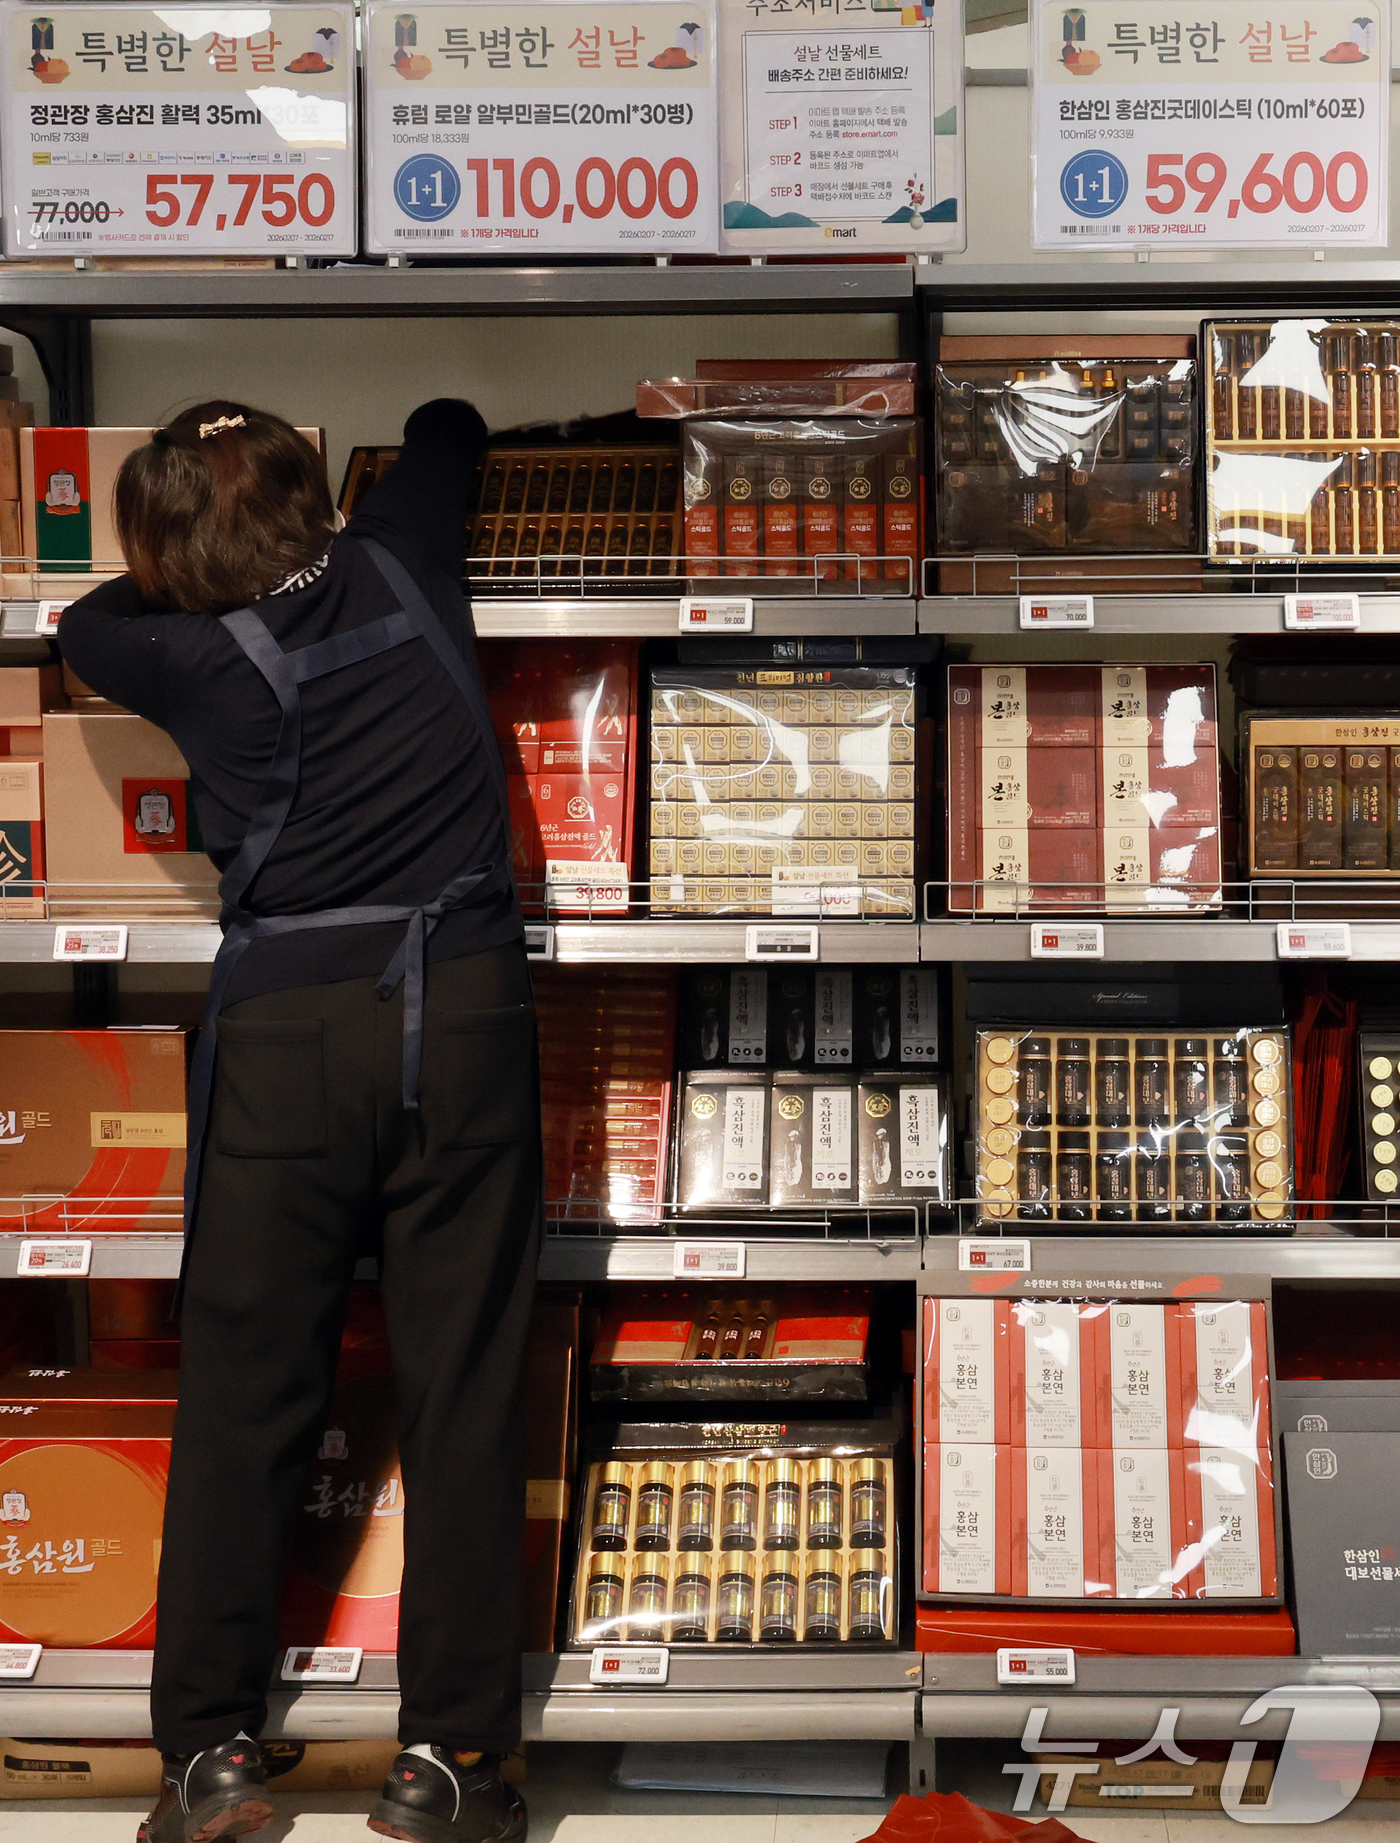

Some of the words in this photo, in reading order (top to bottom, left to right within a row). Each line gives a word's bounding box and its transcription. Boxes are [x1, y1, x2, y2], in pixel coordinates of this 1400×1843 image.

[438, 25, 555, 70] 특별한
[567, 25, 646, 69] 설날
[1107, 20, 1226, 65] 특별한
[1238, 20, 1318, 64] 설날
[75, 31, 192, 73] 특별한
[204, 31, 282, 73] 설날
[793, 45, 822, 63] 설날
[825, 44, 883, 61] 선물세트
[768, 69, 815, 83] 배송주소
[817, 68, 842, 82] 간편
[845, 66, 909, 81] 준비하세요!
[30, 104, 89, 126] 정관장
[95, 104, 154, 126] 홍삼진
[161, 104, 200, 126] 활력
[392, 104, 428, 126] 휴럼
[434, 104, 471, 126] 로얄
[808, 107, 831, 117] 이마트
[832, 107, 840, 116] 앱
[841, 107, 857, 116] 택배
[857, 107, 872, 116] 발송
[875, 106, 889, 115] 주소
[891, 106, 906, 115] 등록
[1059, 100, 1110, 121] 한삼인
[1116, 99, 1252, 121] 홍삼진굿데이스틱
[769, 119, 791, 130] STEP
[793, 116, 798, 130] 1
[808, 119, 831, 128] 이마트
[832, 118, 875, 128] 홈페이지에서
[876, 118, 892, 127] 택배
[893, 118, 908, 127] 발송
[30, 131, 61, 142] 10ml당
[63, 132, 90, 142] 733원
[392, 133, 429, 144] 100ml당
[431, 134, 470, 144] 18,333원
[809, 130, 823, 139] 주소
[826, 130, 840, 139] 등록
[842, 130, 899, 139] store.emart.com
[1059, 129, 1097, 140] 100ml당
[1098, 129, 1135, 140] 9,933원
[770, 155, 792, 166] STEP
[793, 152, 802, 165] 2
[809, 150, 831, 160] 등록된
[833, 150, 855, 159] 주소로
[856, 149, 899, 159] 이마트앱에서
[809, 161, 831, 170] 바코드
[833, 161, 848, 170] 생성
[850, 161, 864, 170] 가능
[407, 170, 448, 208] 1+1
[466, 157, 699, 223] 110,000
[770, 187, 793, 198] STEP
[794, 184, 802, 197] 3
[810, 182, 838, 192] 매장에서
[840, 181, 869, 191] 선물세트
[871, 181, 893, 190] 구매후
[1073, 166, 1116, 204] 1+1
[1145, 151, 1369, 219] 59,600
[31, 188, 60, 198] 일반고객
[60, 188, 91, 198] 구매가격
[810, 192, 853, 202] 택배접수처에
[854, 192, 876, 201] 바코드
[878, 191, 893, 201] 스캔
[146, 173, 336, 231] 57,750
[32, 201, 111, 225] 77,000
[471, 228, 494, 239] 1개당
[495, 228, 540, 239] 가격입니다
[619, 230, 656, 239] 20260207
[662, 230, 697, 239] 20260217
[824, 227, 857, 238] emart
[1137, 224, 1160, 235] 1개당
[1161, 224, 1207, 235] 가격입니다
[1287, 225, 1324, 234] 20260207
[1331, 225, 1366, 234] 20260217
[267, 234, 299, 243] 20260207
[305, 234, 335, 243] 20260217
[691, 612, 705, 620] 1+1
[540, 824, 558, 832] 6년근
[792, 872, 805, 880] 설날
[807, 872, 834, 880] 선물세트
[576, 887, 622, 900] 39,800
[1044, 937, 1057, 945] 1+1
[21, 1111, 52, 1129] 골드
[731, 1096, 746, 1149] 흑삼진액
[819, 1096, 833, 1149] 흑삼진액
[906, 1094, 920, 1147] 흑삼진액
[972, 1254, 985, 1262] 1+1
[1024, 1279, 1058, 1289] 소중한분께
[1062, 1279, 1083, 1289] 건강과
[1085, 1279, 1106, 1289] 감사의
[1107, 1279, 1129, 1289] 마음을
[956, 1364, 978, 1377] 홍삼
[1041, 1368, 1064, 1381] 홍삼
[1127, 1369, 1150, 1383] 홍삼
[956, 1377, 978, 1390] 본연
[1041, 1382, 1064, 1394] 본연
[1127, 1383, 1149, 1396] 본연
[304, 1475, 405, 1518] 홍삼원
[956, 1511, 979, 1524] 홍삼
[1044, 1515, 1066, 1528] 홍삼
[1131, 1516, 1154, 1529] 홍삼
[1219, 1515, 1242, 1528] 홍삼
[956, 1525, 978, 1537] 본연
[1044, 1529, 1066, 1542] 본연
[1131, 1530, 1154, 1543] 본연
[0, 1535, 95, 1575] 홍삼원
[91, 1539, 123, 1557] 골드
[1343, 1549, 1381, 1564] 한삼인
